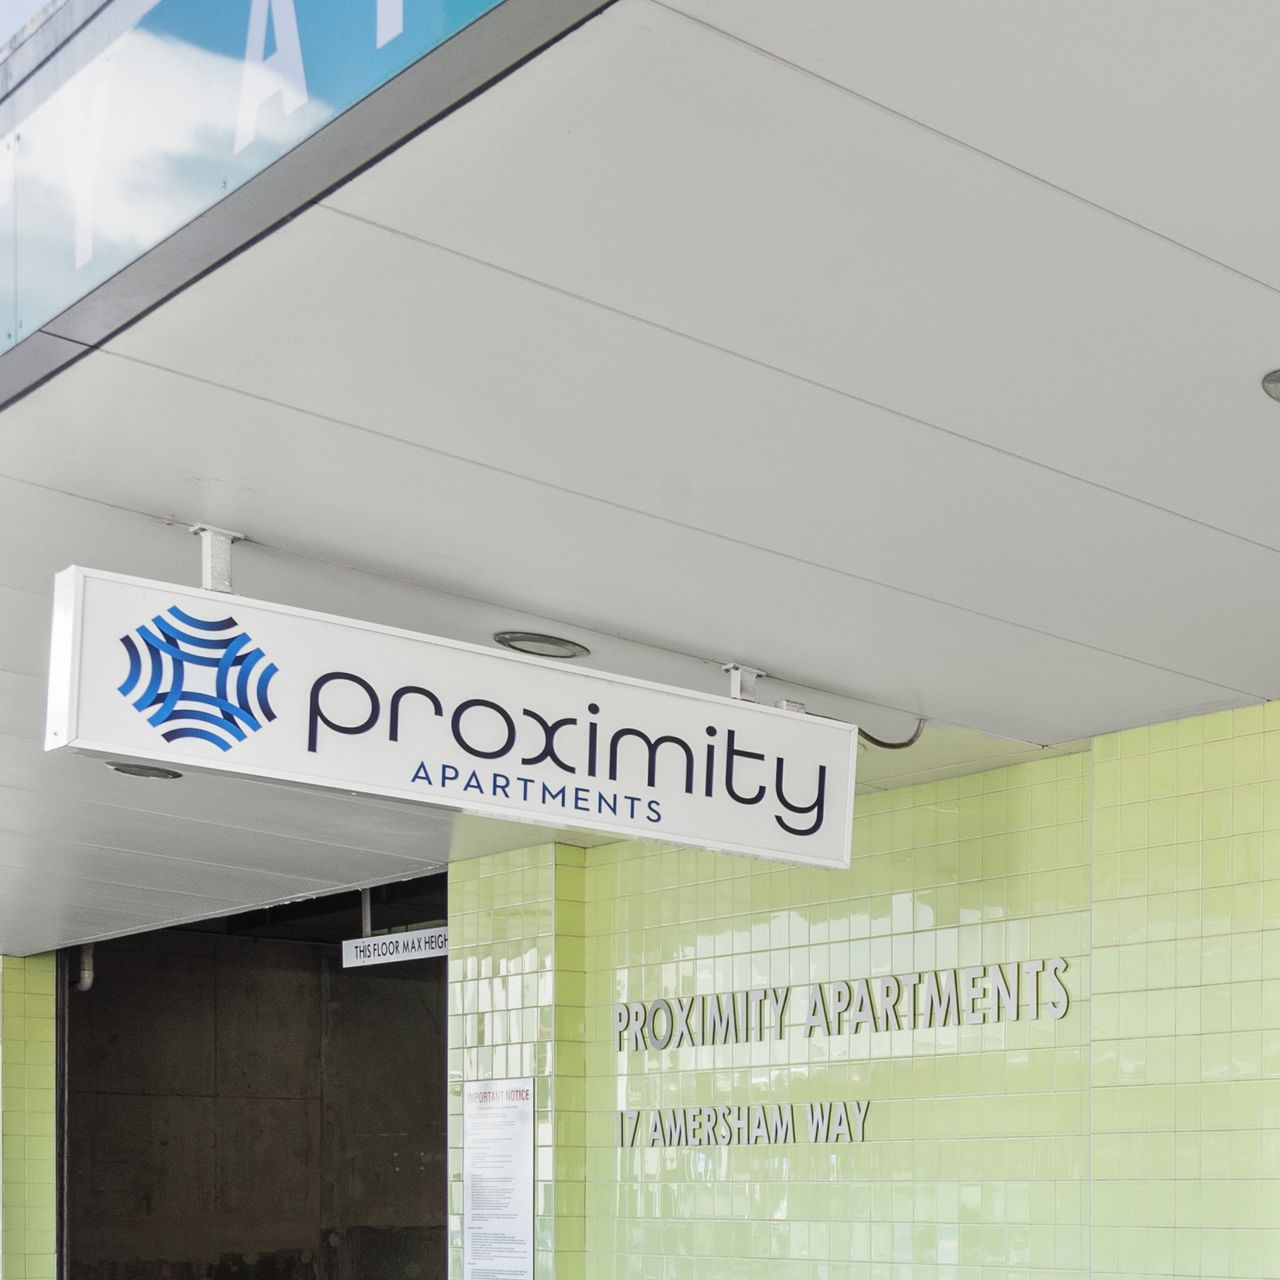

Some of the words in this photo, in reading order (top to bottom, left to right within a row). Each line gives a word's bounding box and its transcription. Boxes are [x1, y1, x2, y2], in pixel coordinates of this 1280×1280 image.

[307, 671, 827, 837] proximity
[410, 760, 662, 823] APARTMENTS
[355, 943, 371, 960] THIS
[373, 940, 400, 957] FLOOR
[402, 937, 422, 953] MAX
[614, 986, 789, 1051] PROXIMITY
[804, 956, 1069, 1038] APARTMENTS
[506, 1089, 530, 1101] NOTICE
[617, 1111, 640, 1147] 17
[650, 1103, 796, 1147] AMERSHAM
[806, 1100, 871, 1143] WAY
